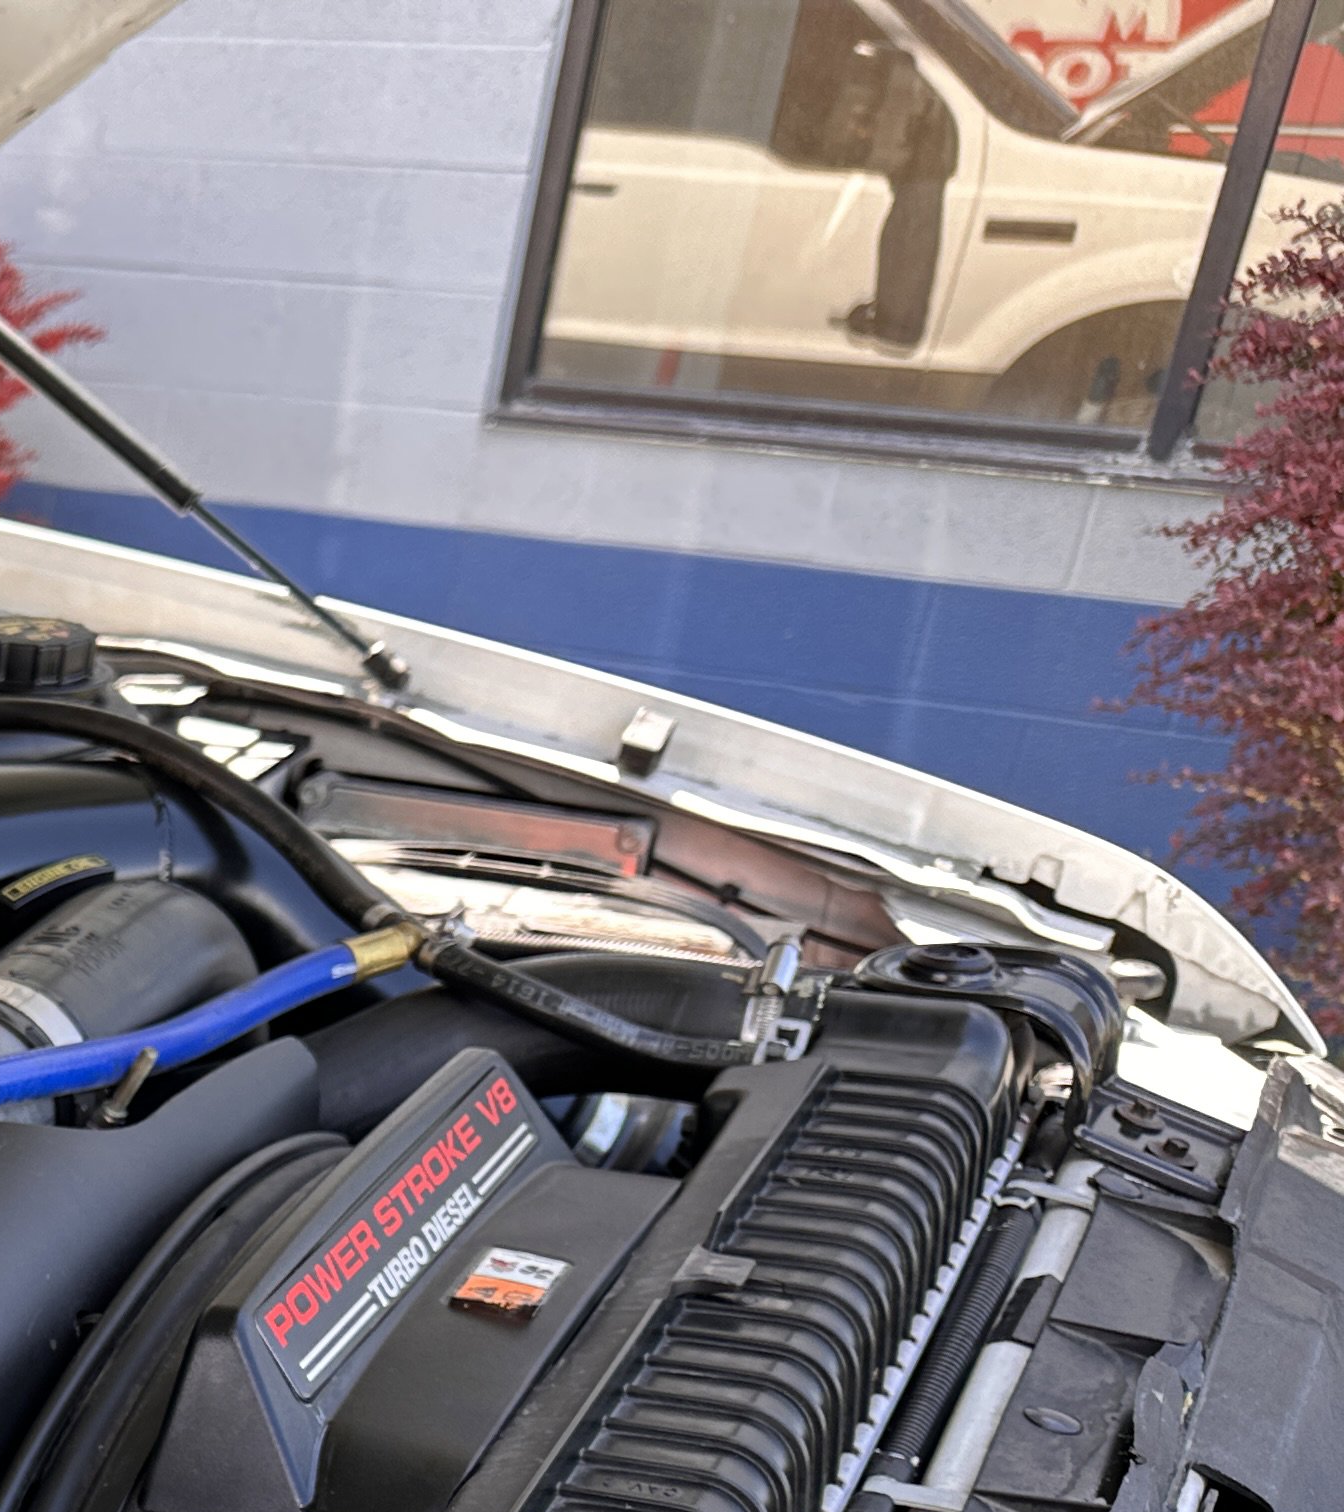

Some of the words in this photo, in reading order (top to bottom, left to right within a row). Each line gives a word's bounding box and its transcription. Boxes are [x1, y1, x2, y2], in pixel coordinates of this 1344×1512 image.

[257, 1218, 387, 1347] POWER
[365, 1114, 488, 1237] STROKE
[472, 1076, 524, 1127] V8
[364, 1235, 433, 1307] TURBO
[415, 1178, 486, 1252] DIESEL
